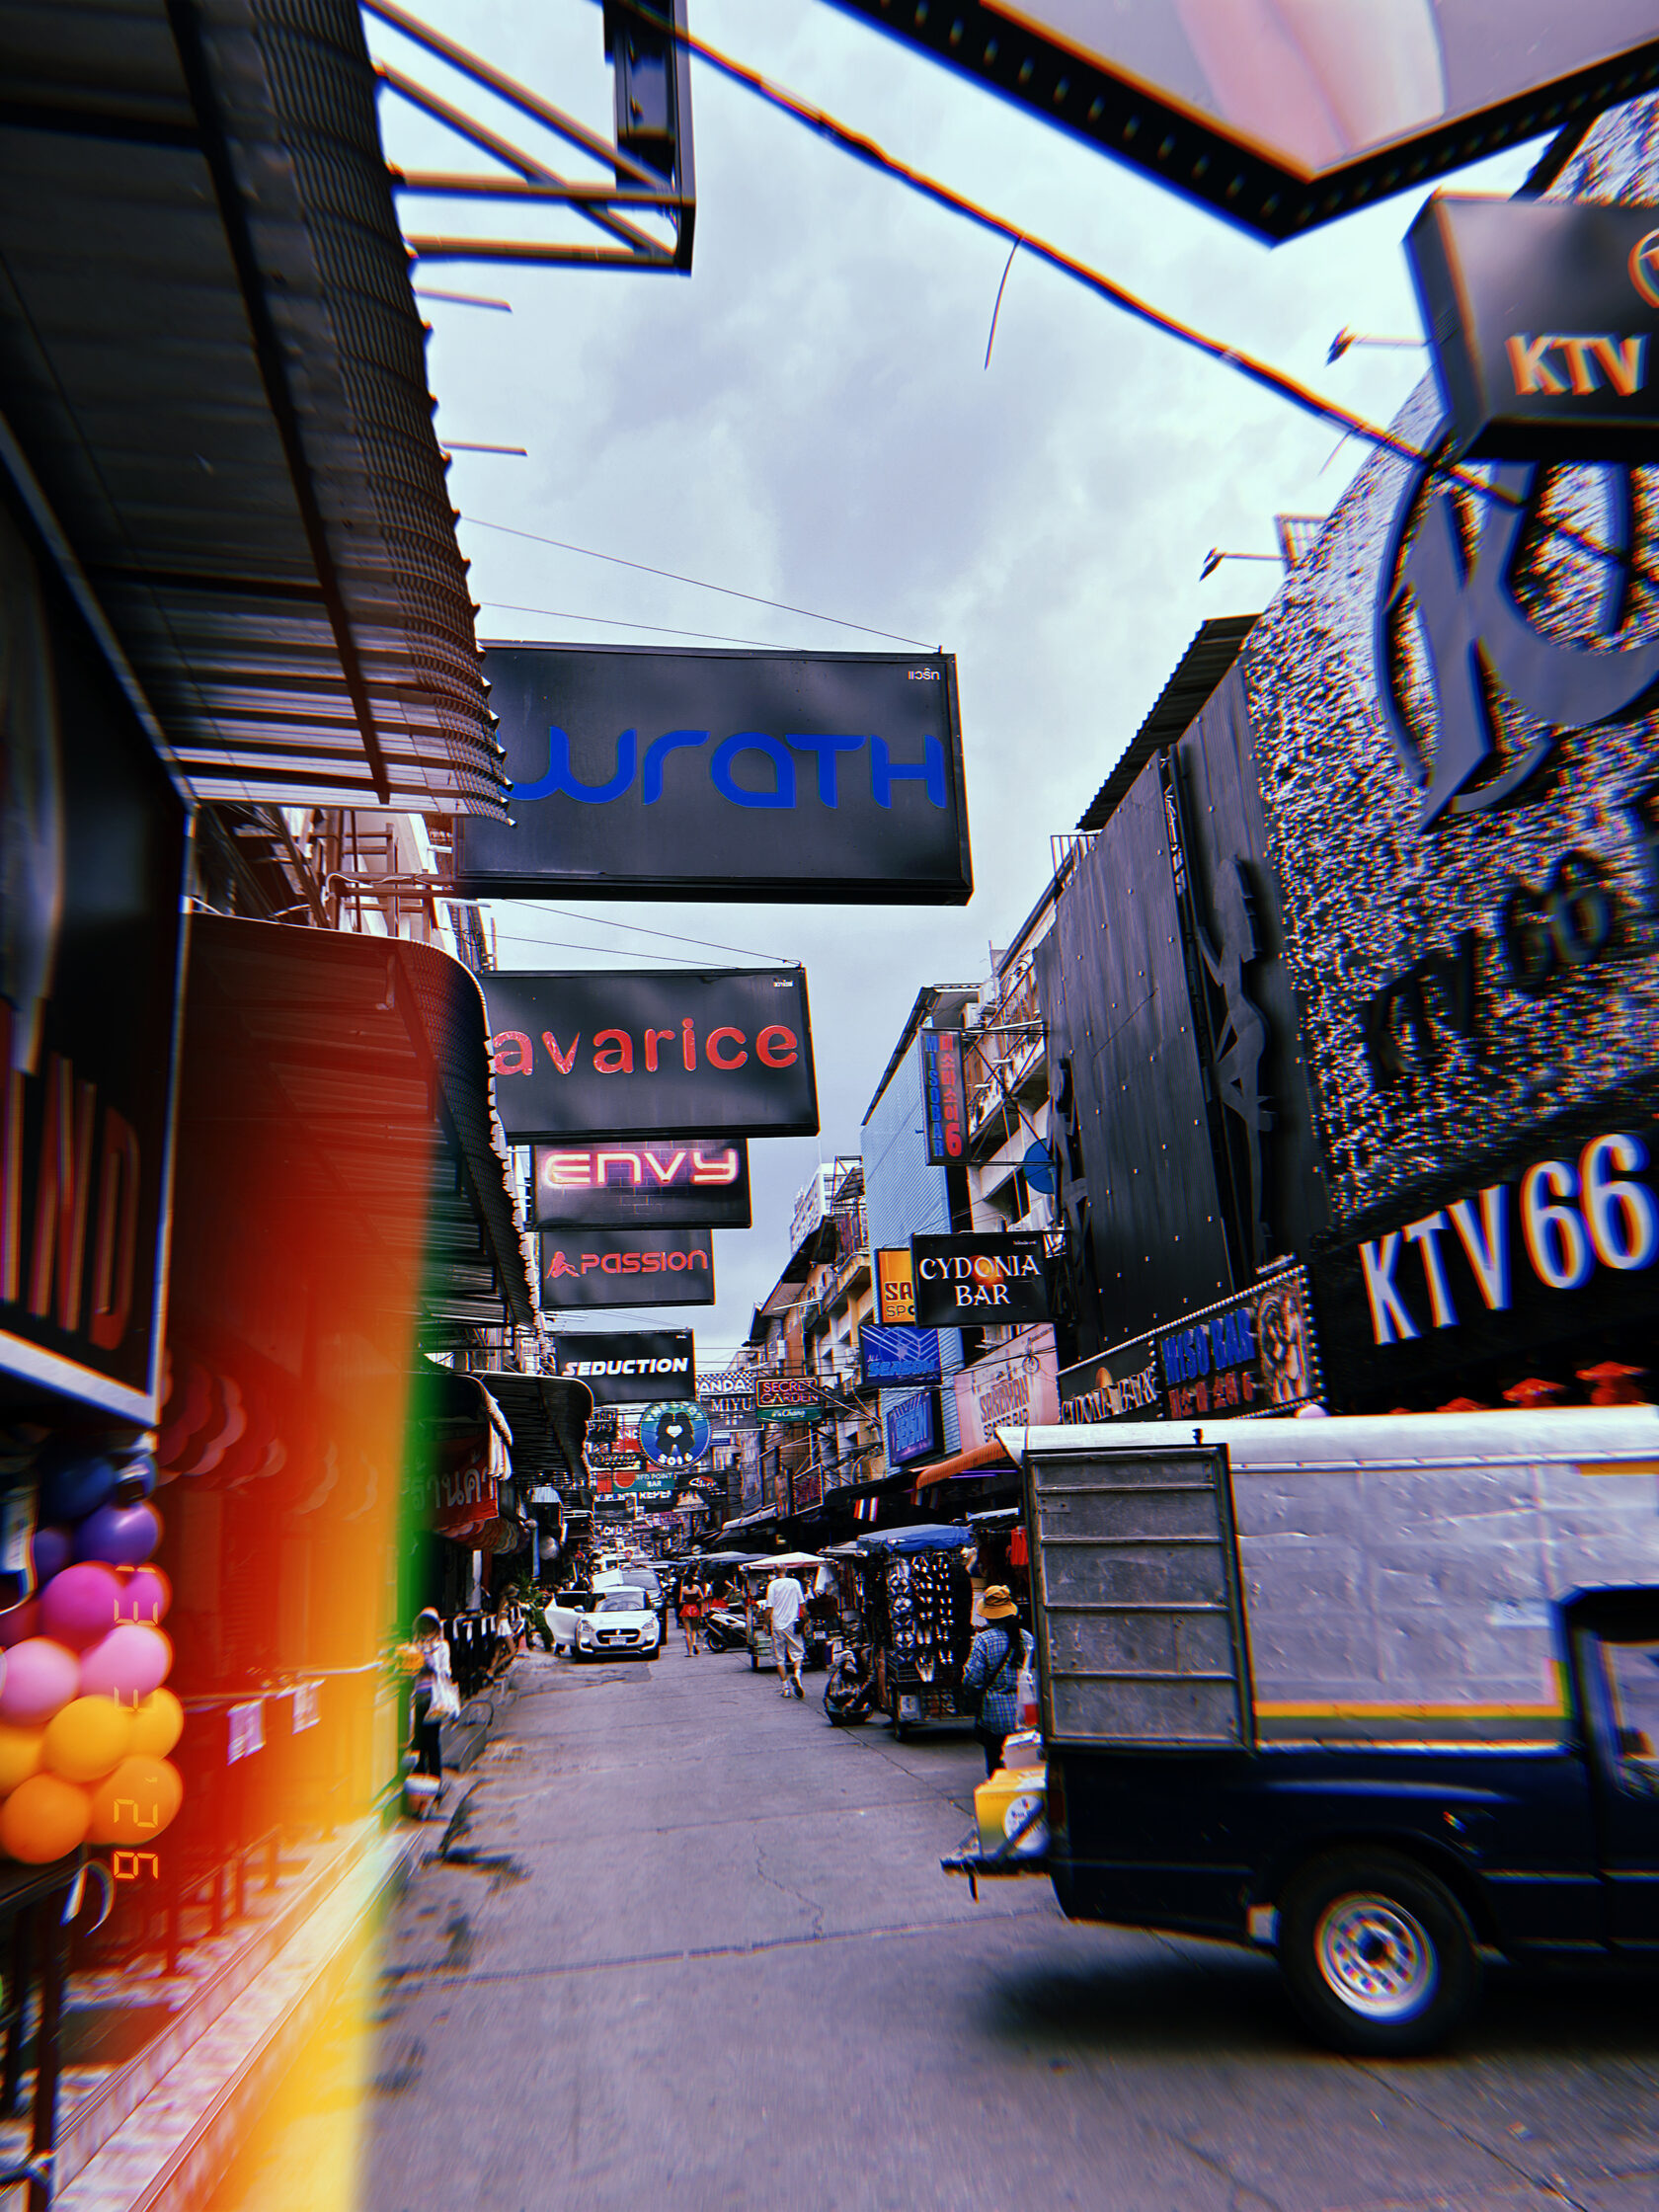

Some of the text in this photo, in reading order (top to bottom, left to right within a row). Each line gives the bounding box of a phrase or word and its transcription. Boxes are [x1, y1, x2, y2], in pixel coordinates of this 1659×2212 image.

[1504, 331, 1651, 396] KTV
[494, 1018, 799, 1076] avarice
[1358, 1132, 1659, 1346] KTV 66
[918, 1254, 1041, 1280] CYDONIA
[955, 1284, 1011, 1306] BAR
[1161, 1307, 1256, 1385] MISO BAR
[561, 1357, 688, 1377] SEDUCTION
[760, 1392, 819, 1404] GARDEN
[762, 1381, 815, 1392] SECRET
[710, 1397, 751, 1412] MIYU
